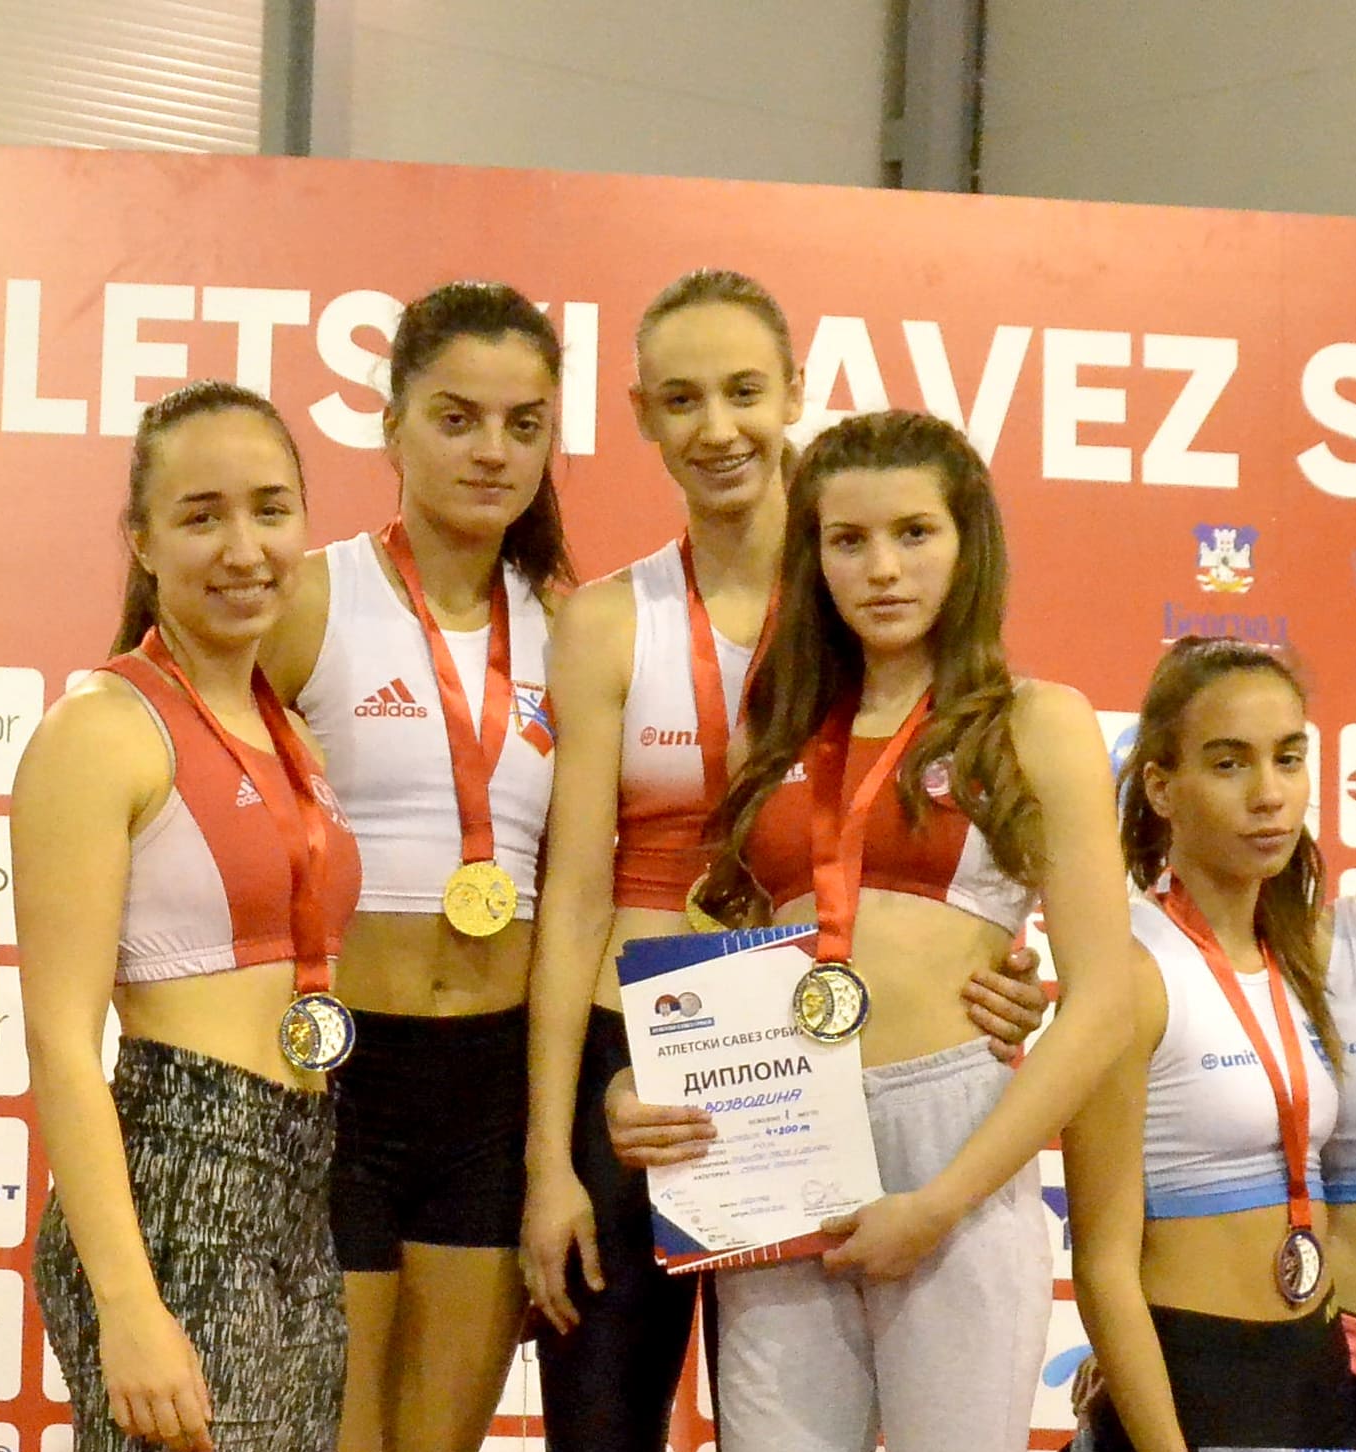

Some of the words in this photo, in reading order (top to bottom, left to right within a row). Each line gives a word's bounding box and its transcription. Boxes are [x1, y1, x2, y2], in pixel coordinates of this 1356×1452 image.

[800, 314, 1240, 490] AVEZ
[354, 701, 428, 718] adidas
[657, 1038, 721, 1057] АТЛЕТСКИ
[722, 1031, 763, 1048] САВЕЗ
[765, 1025, 805, 1042] СРБИ
[1221, 1050, 1259, 1068] unit
[684, 1056, 812, 1095] ДИПЛОМА
